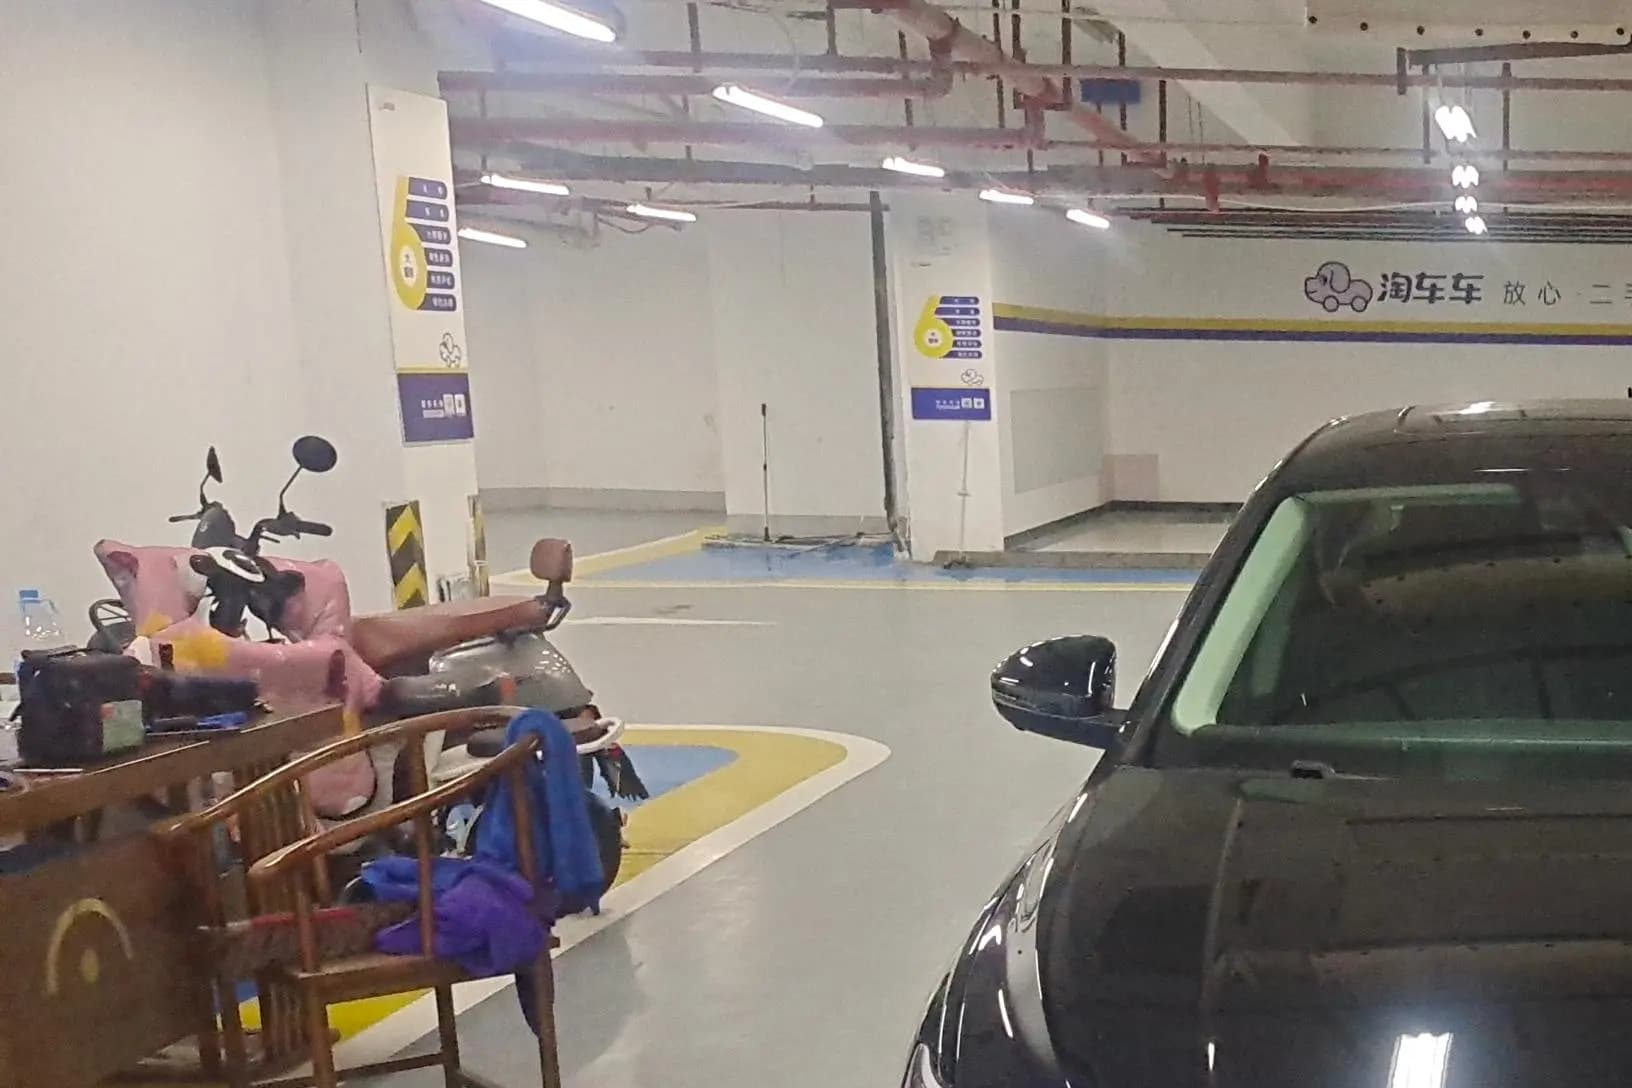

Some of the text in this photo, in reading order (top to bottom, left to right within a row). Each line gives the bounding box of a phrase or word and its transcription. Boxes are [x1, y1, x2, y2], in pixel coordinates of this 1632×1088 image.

[1377, 272, 1484, 304] 淘车车
[1503, 281, 1561, 306] 放心
